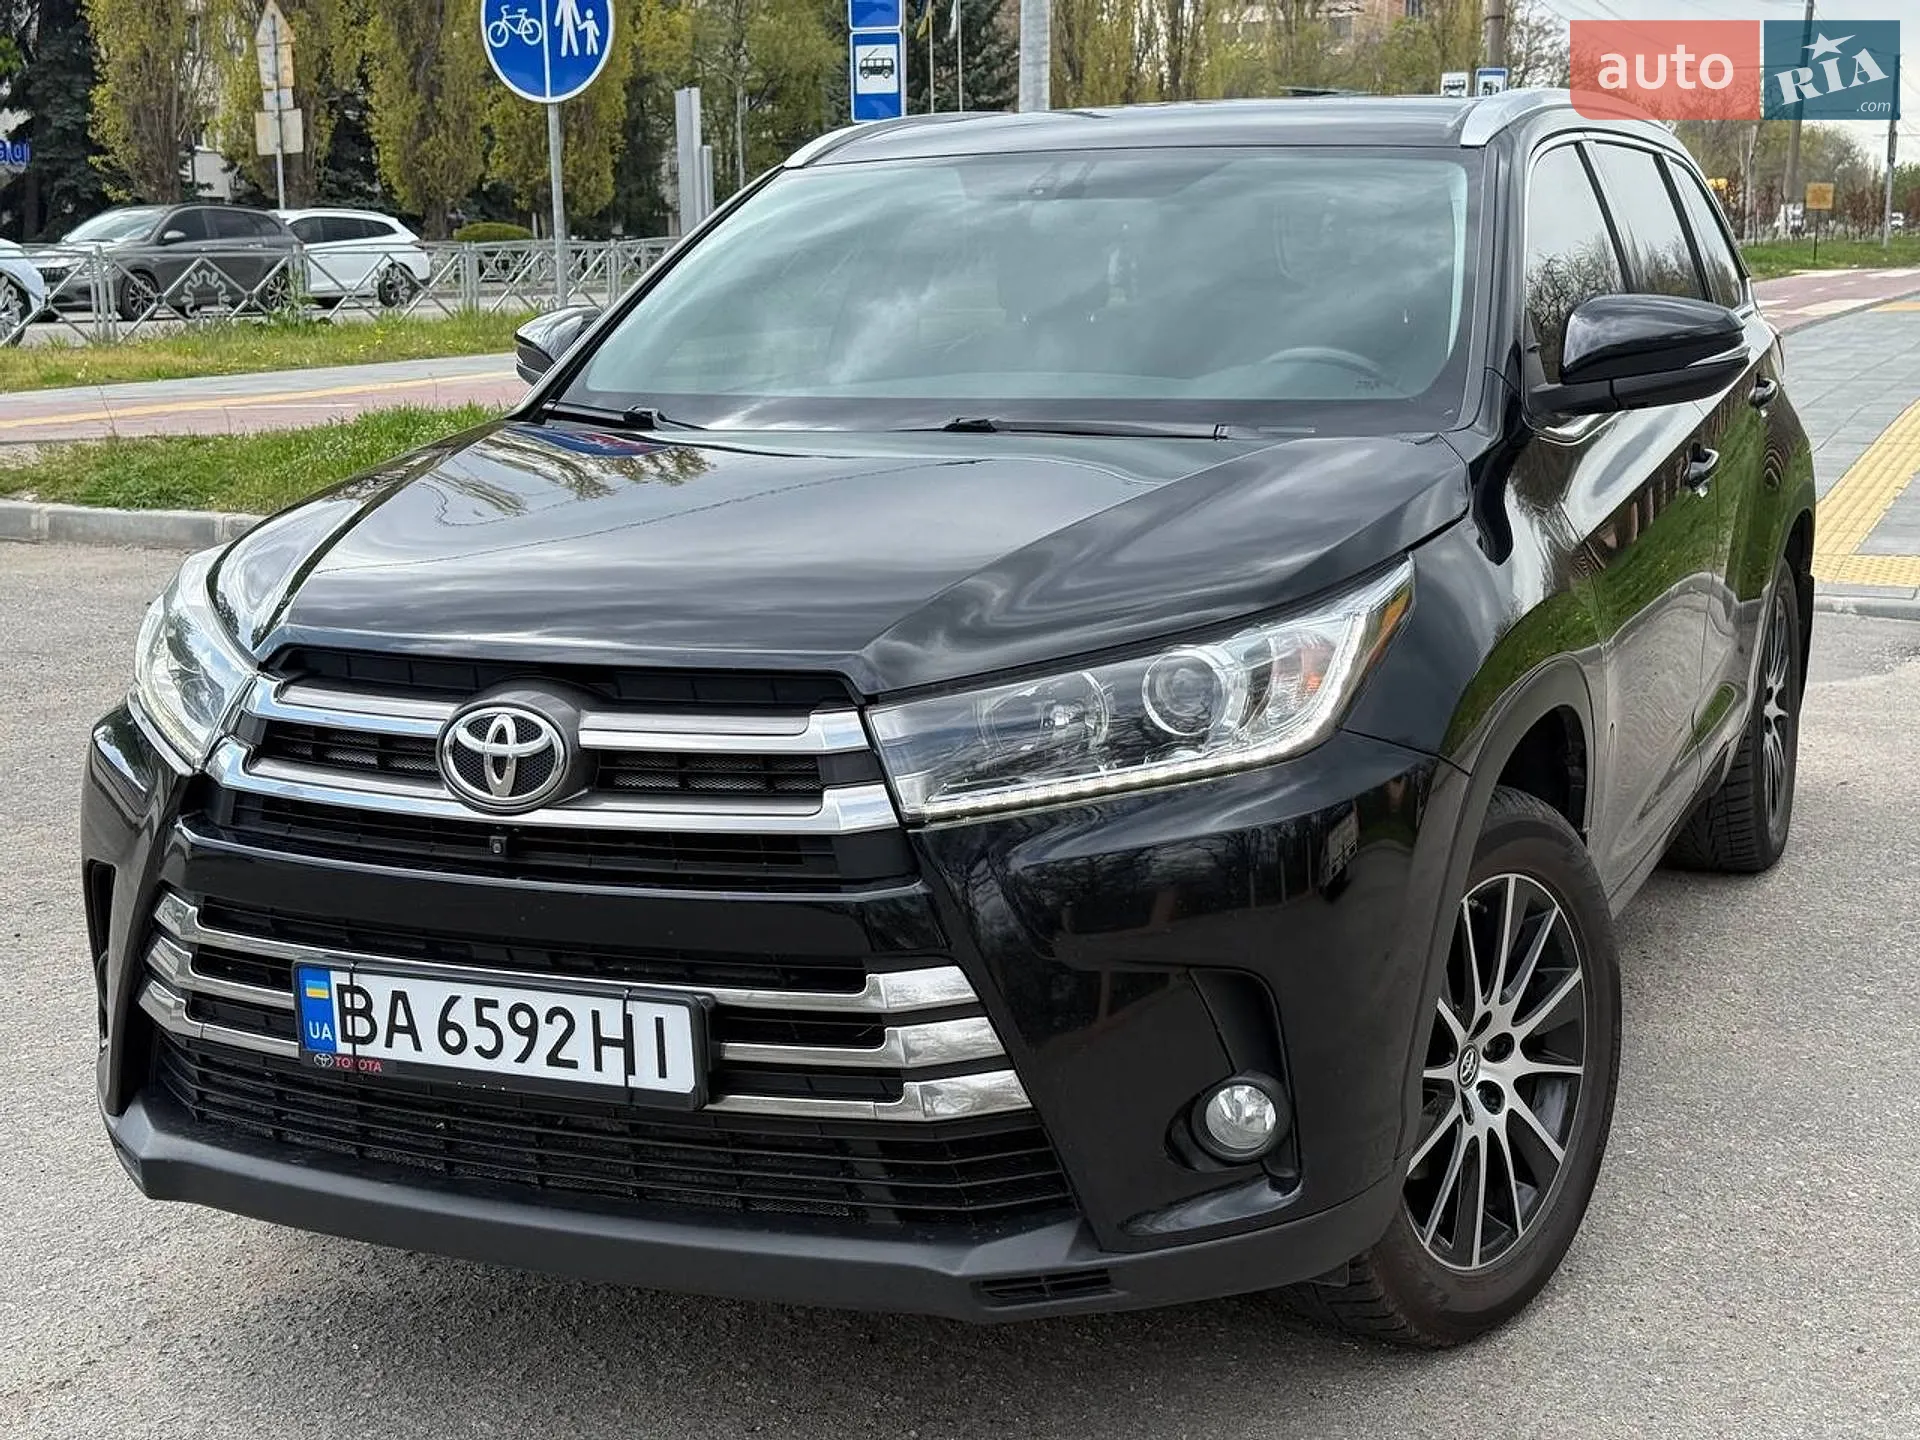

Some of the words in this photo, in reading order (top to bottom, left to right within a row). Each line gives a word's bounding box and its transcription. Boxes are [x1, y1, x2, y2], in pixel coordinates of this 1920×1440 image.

[309, 1021, 333, 1041] UA
[336, 983, 423, 1052] BA
[437, 995, 579, 1070] 6592
[591, 1009, 667, 1079] HI
